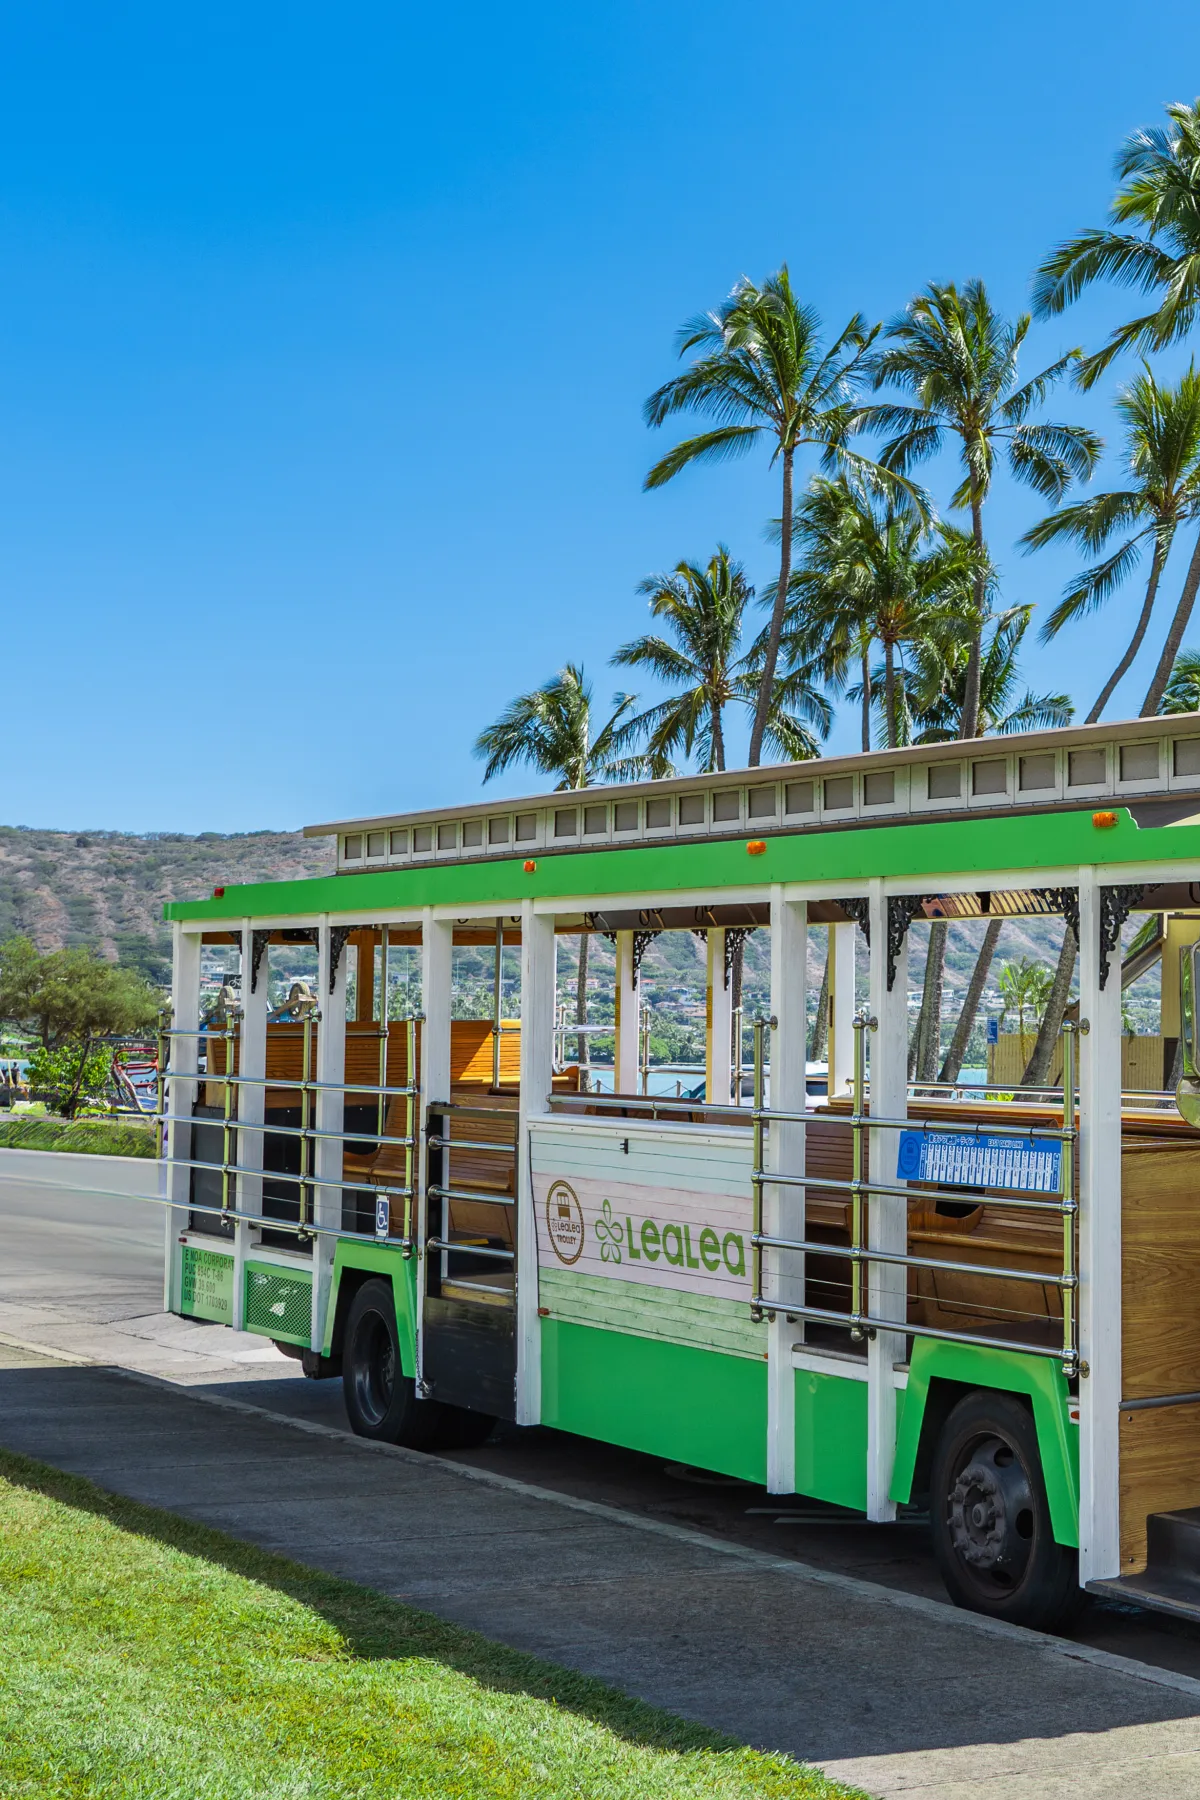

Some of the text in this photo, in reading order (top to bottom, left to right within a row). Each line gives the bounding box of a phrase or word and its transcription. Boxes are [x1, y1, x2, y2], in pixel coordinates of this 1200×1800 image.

[556, 1234, 577, 1246] TROLLEY
[625, 1216, 747, 1278] LeaLea
[185, 1249, 190, 1261] E
[190, 1250, 203, 1263] NOA
[192, 1291, 205, 1305] DOT
